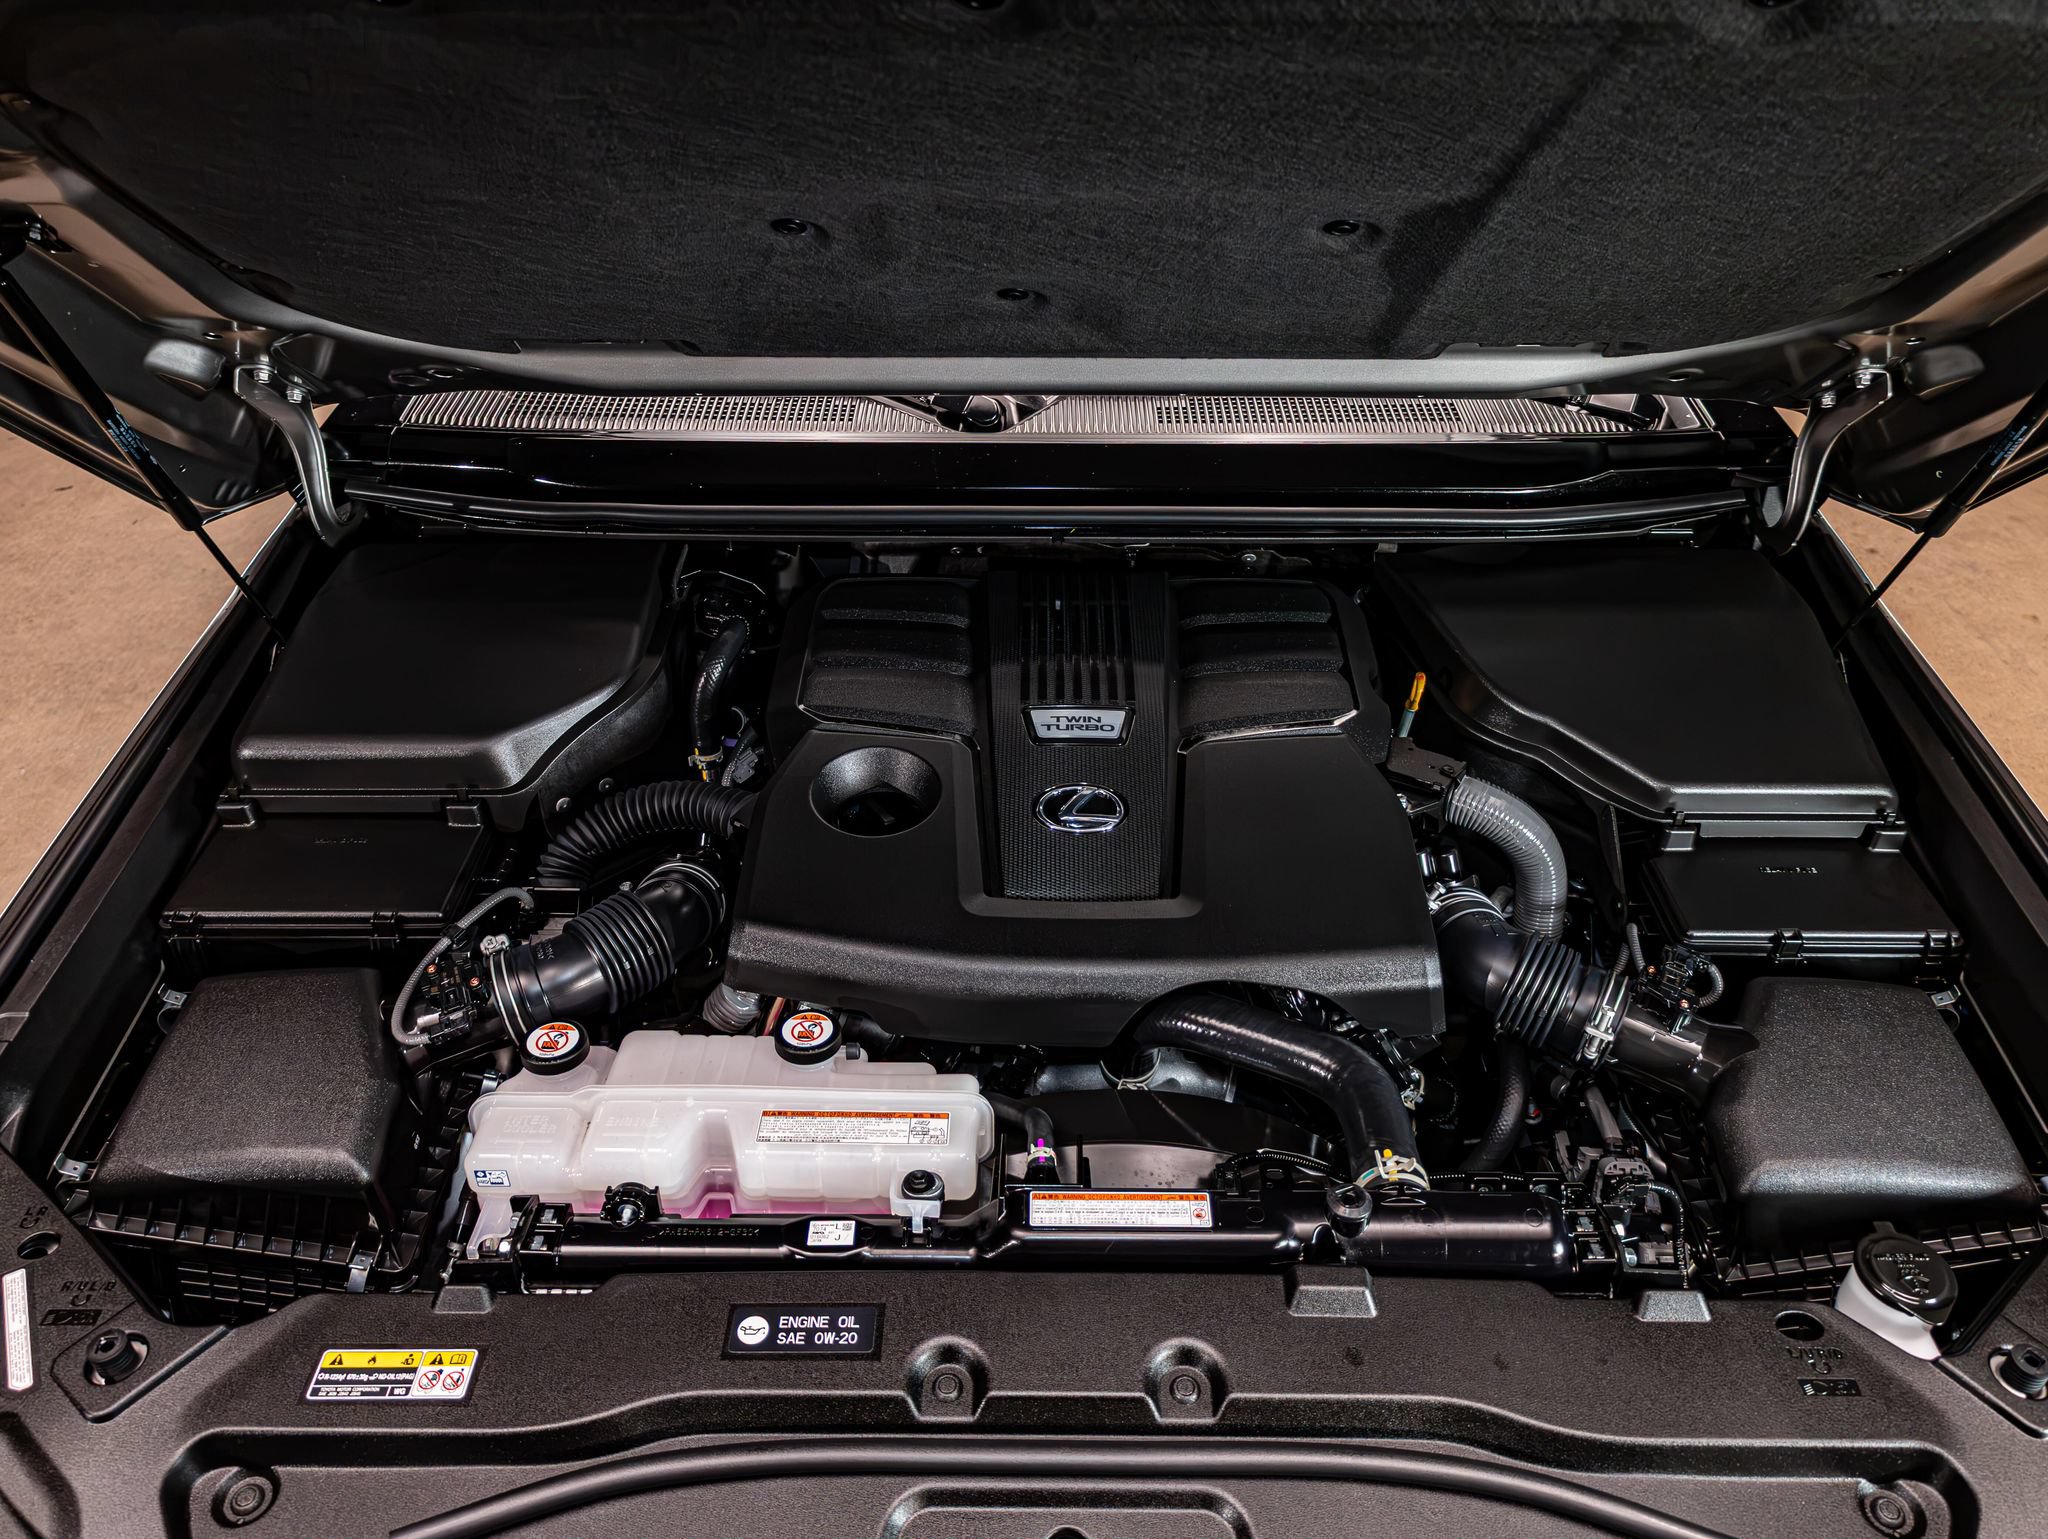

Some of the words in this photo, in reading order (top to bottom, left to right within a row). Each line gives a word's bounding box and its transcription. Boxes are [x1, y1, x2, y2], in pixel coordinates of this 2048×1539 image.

[1041, 724, 1115, 732] TURBO
[778, 1315, 830, 1329] ENGINE
[838, 1315, 860, 1329] OIL
[776, 1332, 806, 1345] SAE
[814, 1332, 858, 1345] 0W-20
